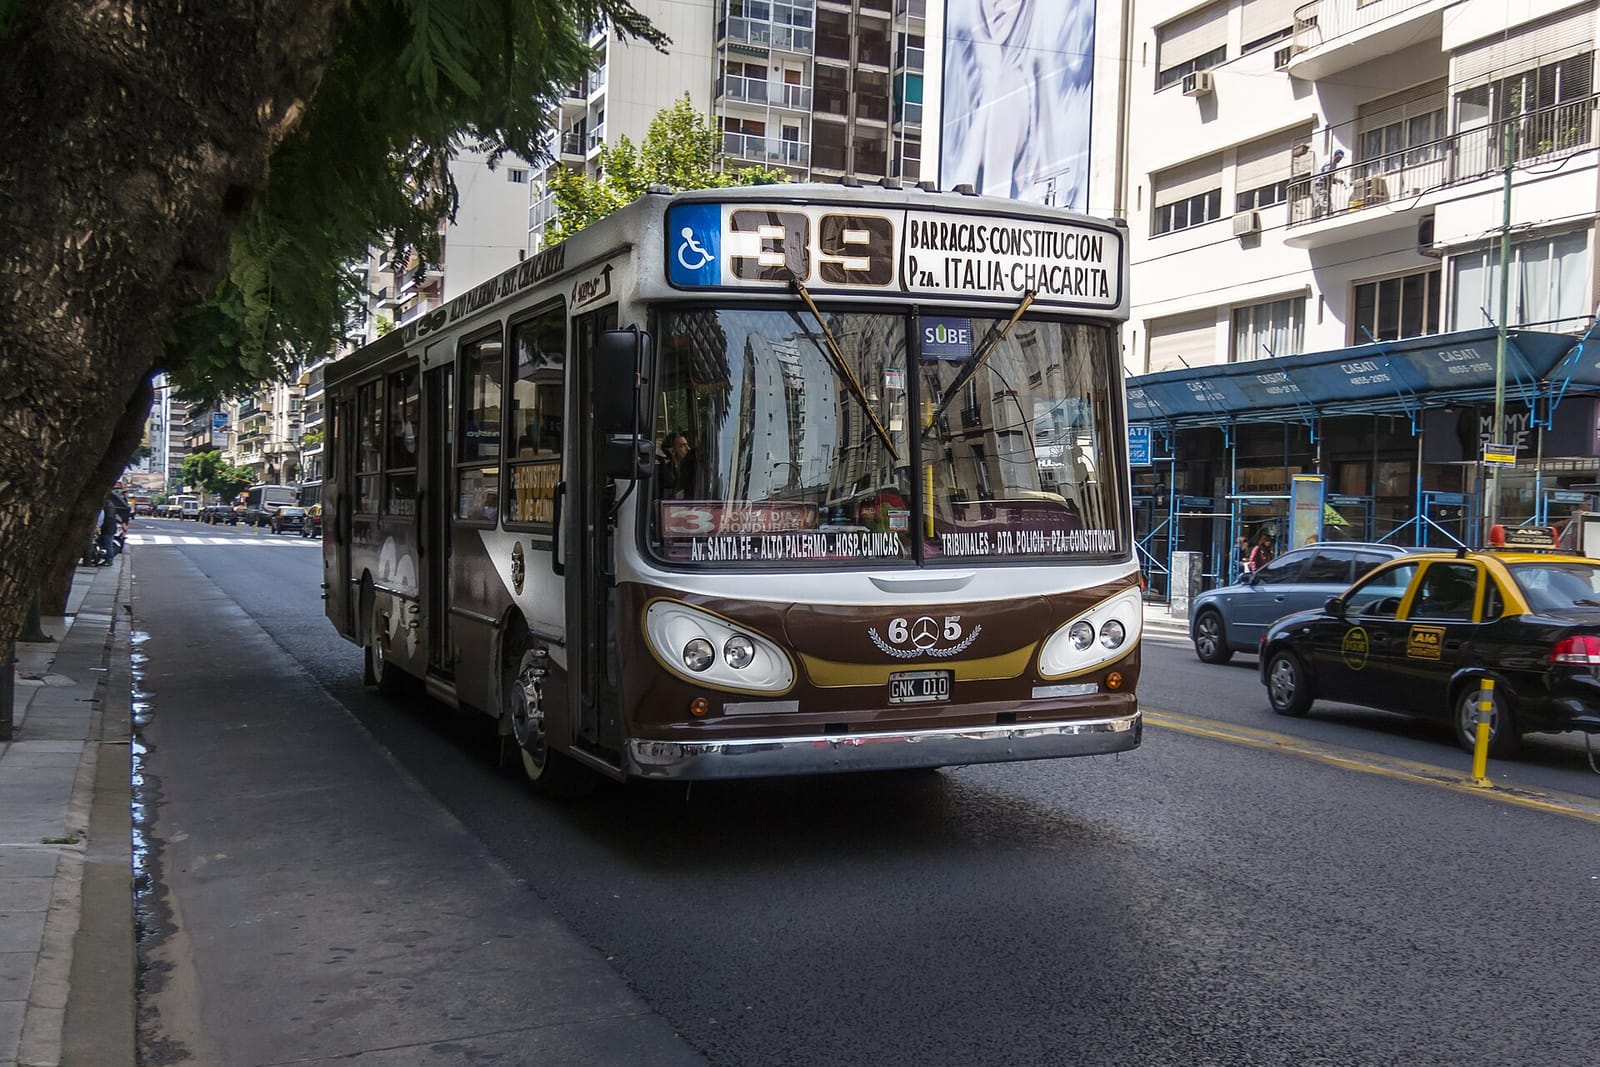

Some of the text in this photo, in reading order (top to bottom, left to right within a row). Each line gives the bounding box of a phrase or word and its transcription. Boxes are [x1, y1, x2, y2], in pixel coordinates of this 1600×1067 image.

[729, 207, 895, 287] 39
[925, 325, 968, 344] SUBE
[1438, 347, 1481, 362] CASATI
[1340, 360, 1379, 375] CASATI
[1480, 412, 1530, 434] MMY
[670, 510, 715, 534] 3
[707, 536, 738, 561] SANTA
[740, 536, 752, 560] FE
[760, 535, 783, 559] ALTO
[785, 534, 827, 558] PALERMO
[861, 531, 899, 557] CLINICAS
[942, 532, 989, 556] TRIBUNALES
[1016, 530, 1045, 553] POLICIA
[1069, 529, 1116, 552] CONSTITUCION
[1413, 632, 1438, 644] Alé
[891, 678, 947, 698] GNK 010
